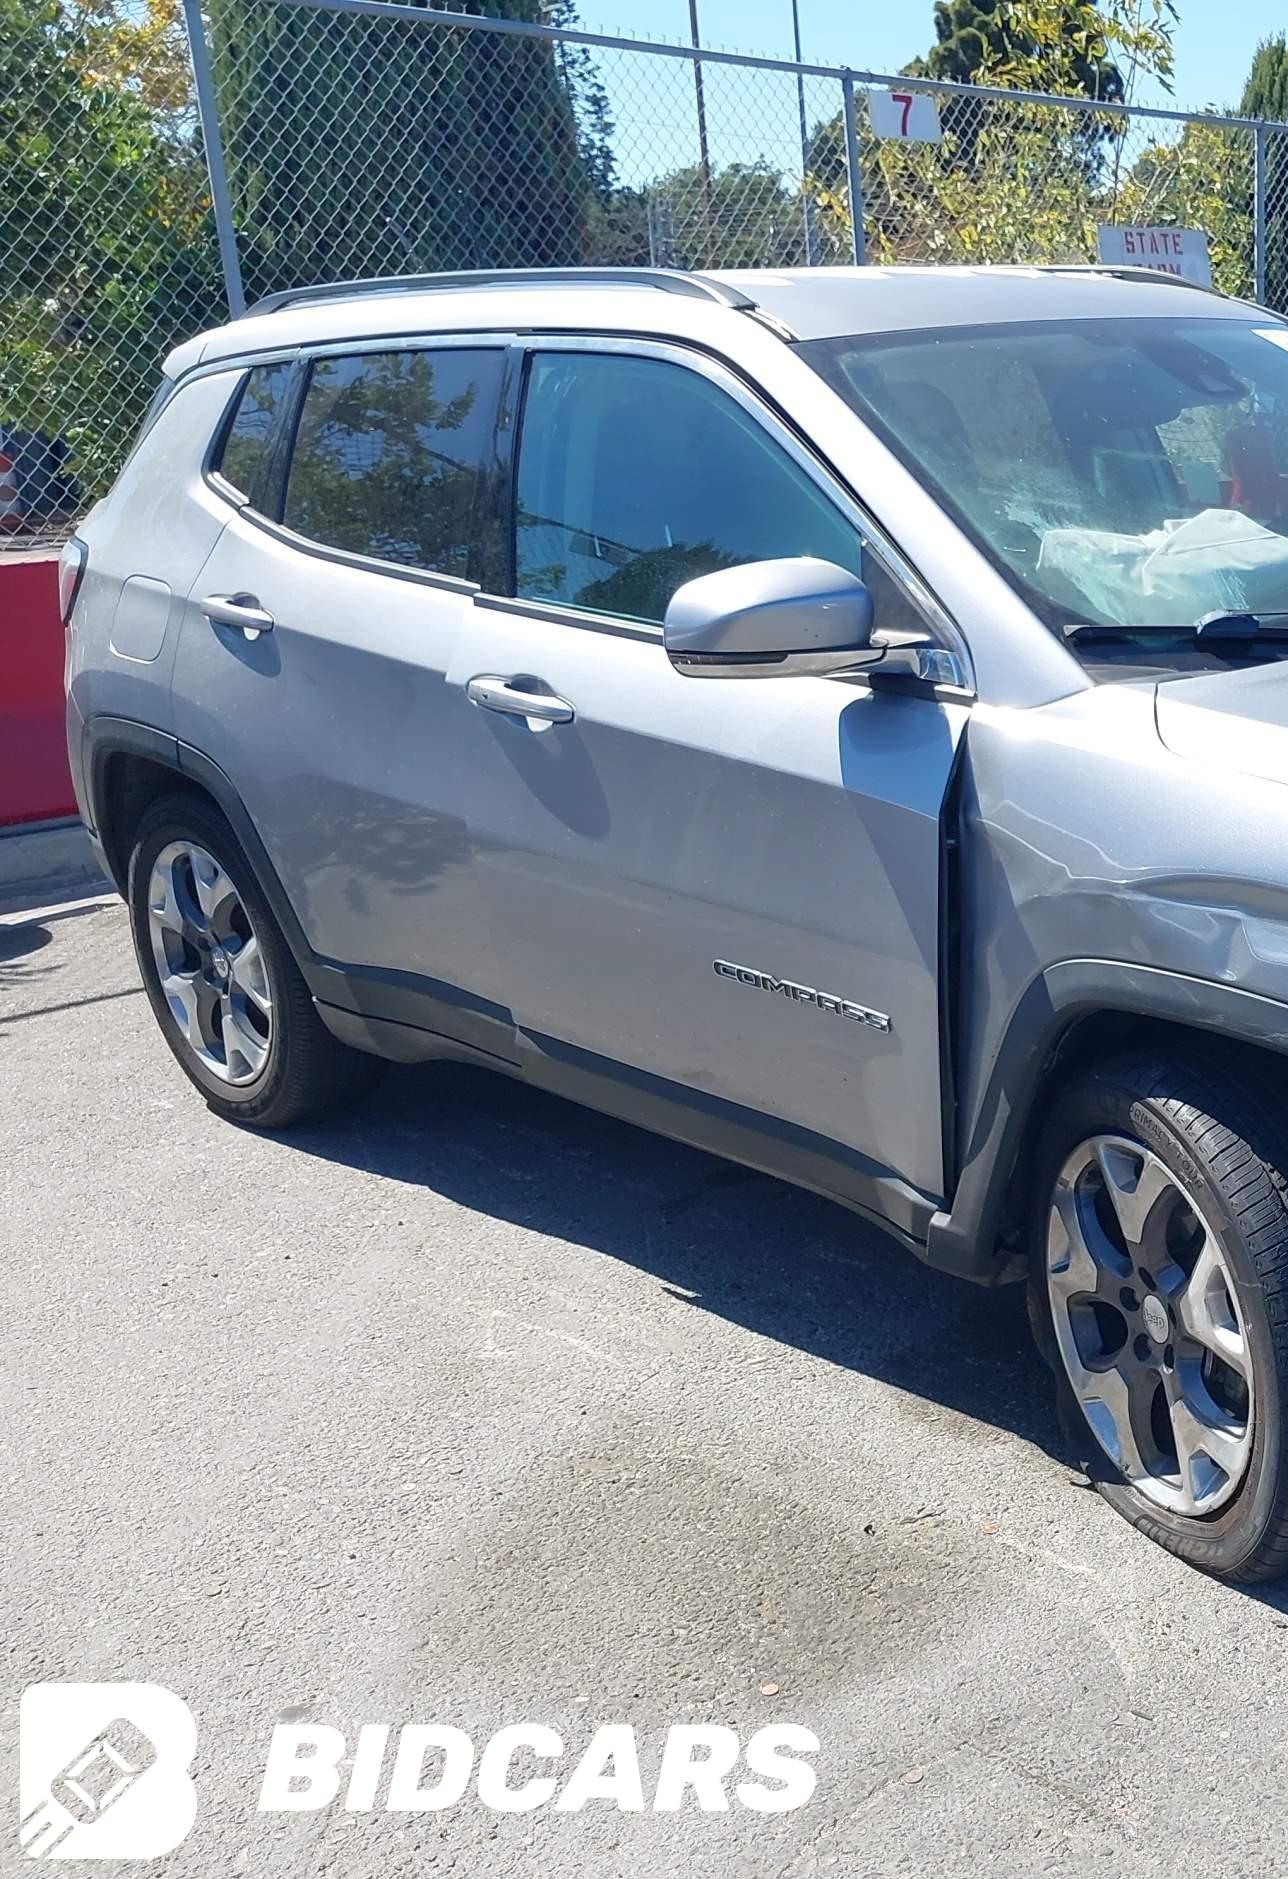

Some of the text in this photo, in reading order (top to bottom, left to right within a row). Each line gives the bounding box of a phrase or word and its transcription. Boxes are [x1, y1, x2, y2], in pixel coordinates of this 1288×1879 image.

[892, 94, 913, 137] 7
[1124, 231, 1184, 256] STATE
[713, 958, 892, 1034] COMPASS
